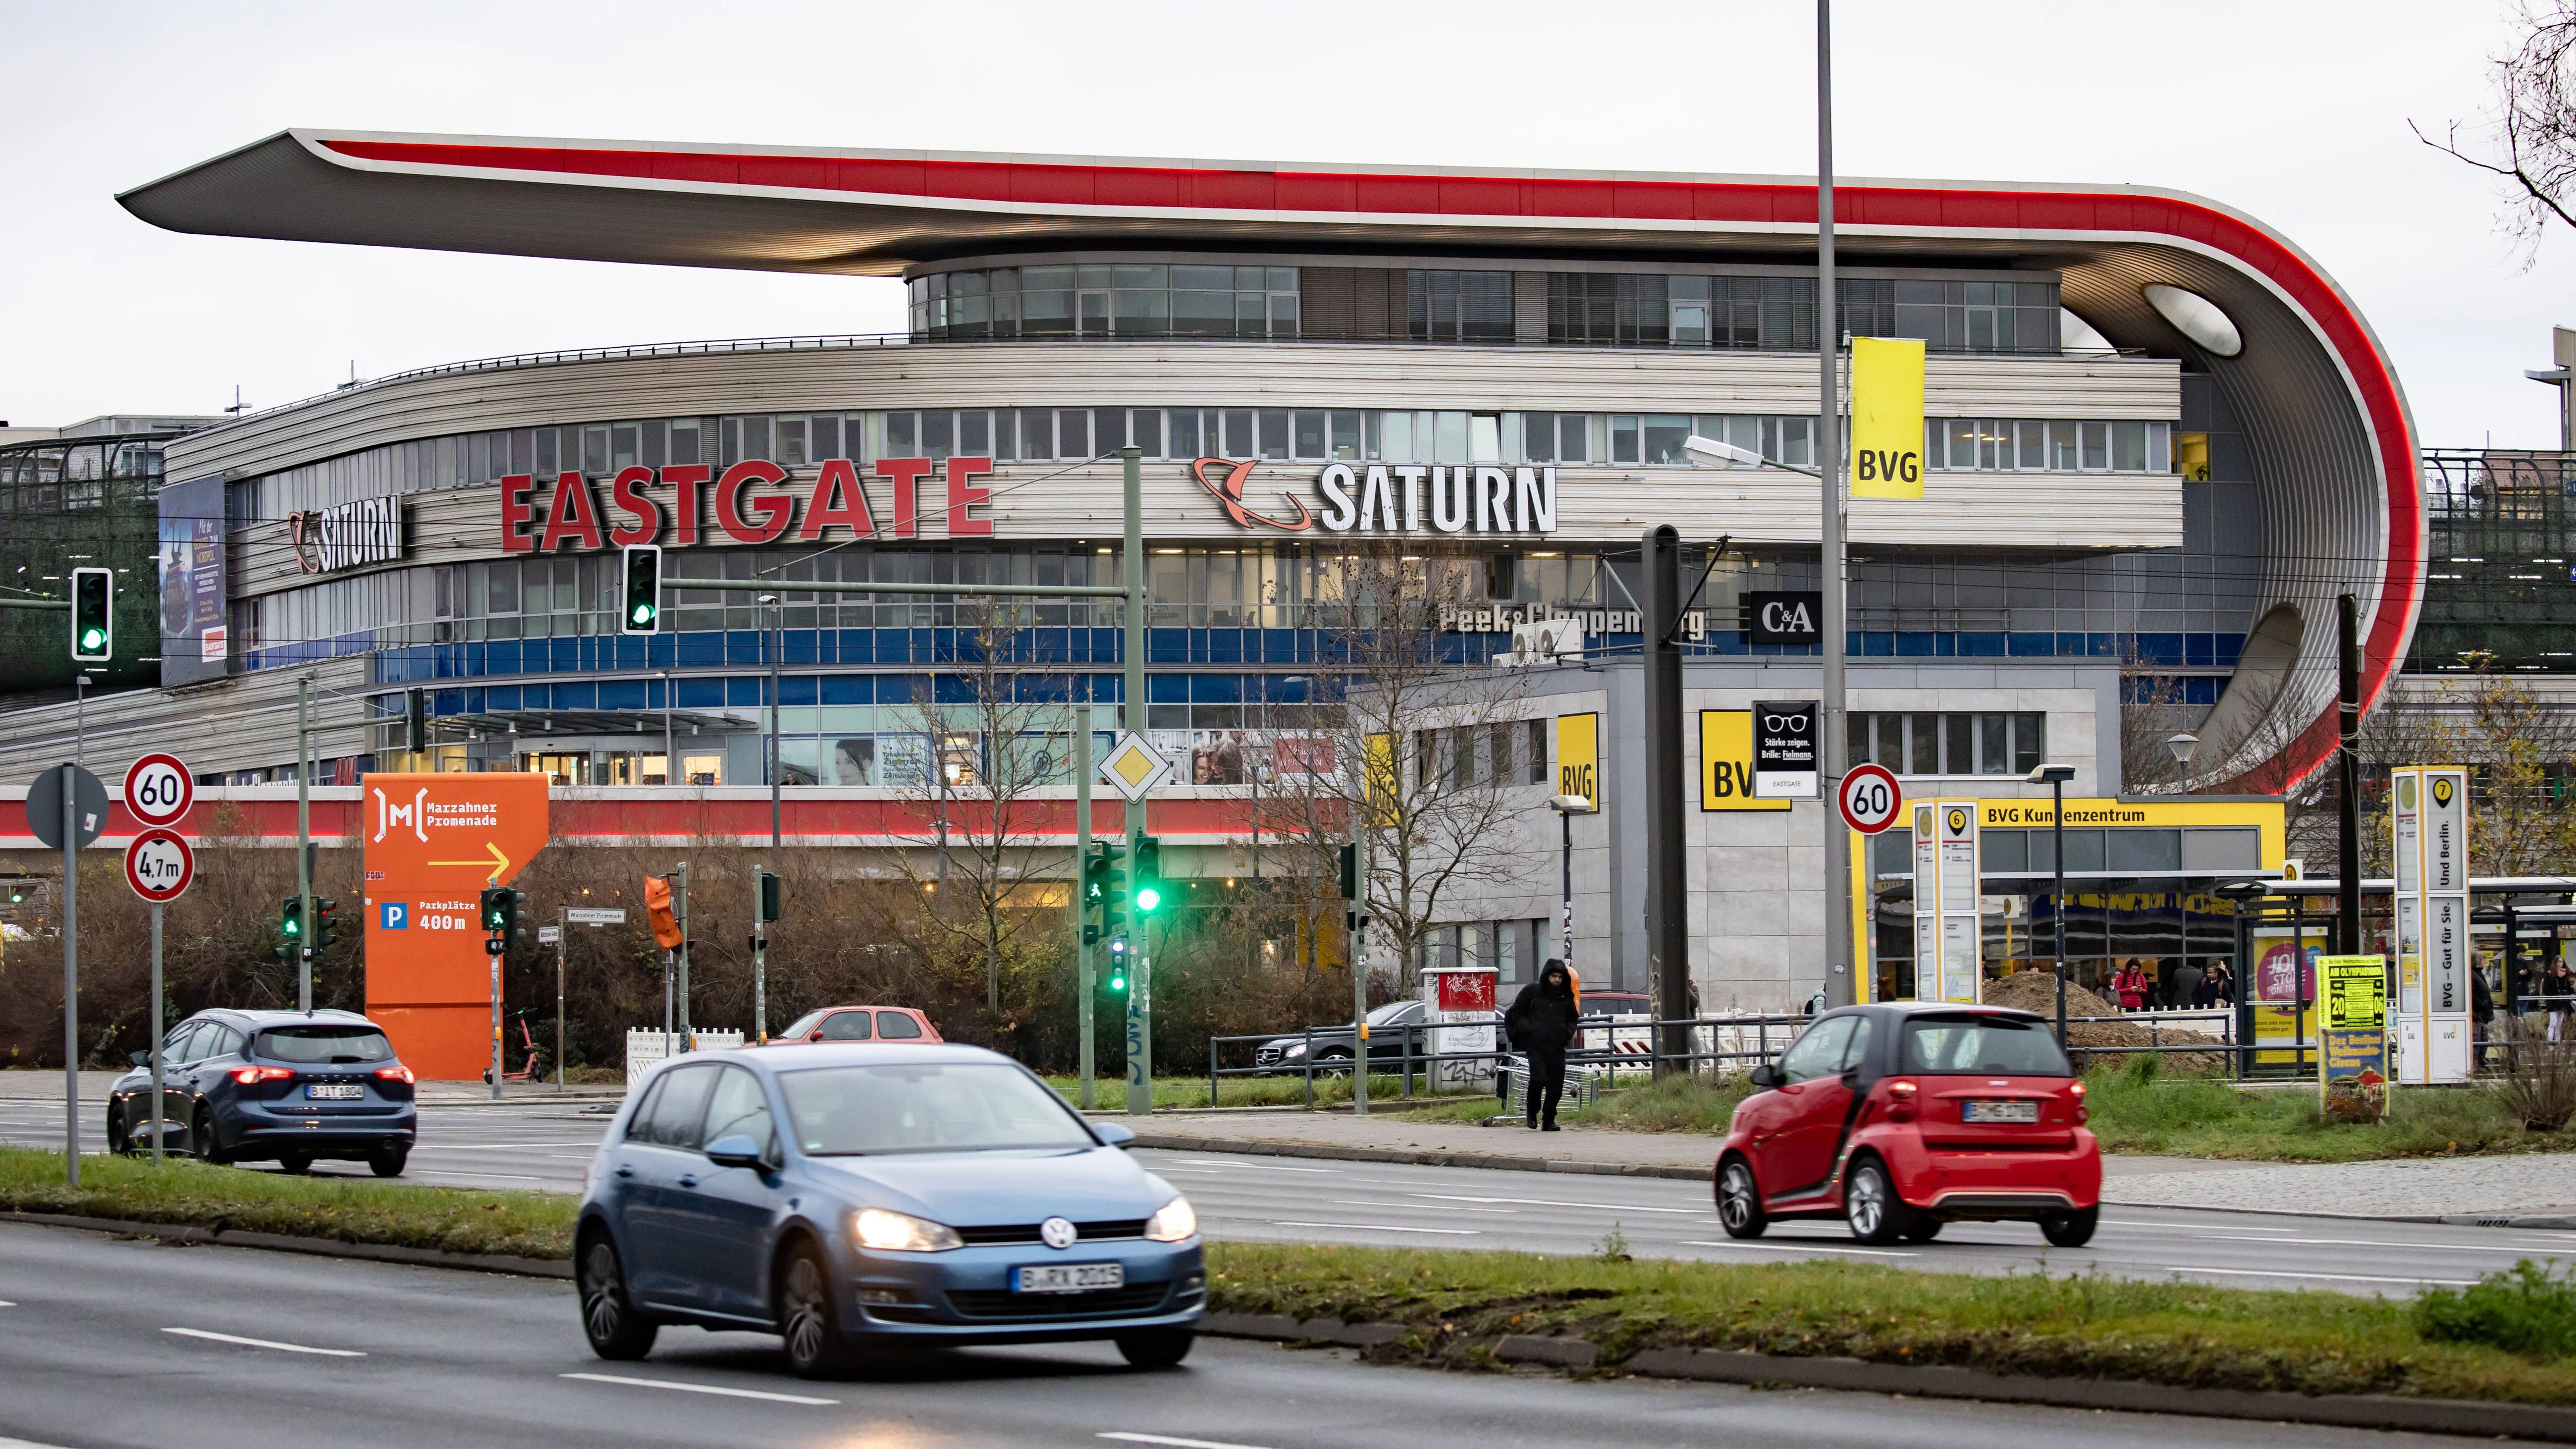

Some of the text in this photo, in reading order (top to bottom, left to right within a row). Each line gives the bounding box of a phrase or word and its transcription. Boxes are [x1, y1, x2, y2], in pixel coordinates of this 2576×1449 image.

[1859, 449, 1917, 483] BVG
[500, 456, 994, 553] EASTGATE
[1320, 463, 1557, 532] SATURN
[322, 495, 397, 572] SATURN
[1762, 602, 1815, 632] C&A
[1765, 738, 1810, 748] Stärke zeigen.
[1762, 750, 1814, 760] Brille: Fielmann.
[1562, 763, 1592, 801] BVG
[1714, 761, 1753, 798] BV
[140, 774, 177, 805] 60
[2439, 785, 2446, 796] 7
[427, 802, 497, 813] Marzahner
[1853, 785, 1888, 815] 60
[427, 815, 497, 826] Promenade
[1954, 815, 1960, 825] 6
[1988, 808, 2145, 823] BVG Kunenzentrum
[2439, 820, 2450, 886] Und Berlin.
[166, 863, 179, 877] m
[420, 901, 476, 911] Parkplätze
[2441, 902, 2451, 923] Sie.
[388, 907, 402, 927] P
[420, 915, 466, 930] 400 m
[2442, 927, 2451, 945] für
[2443, 948, 2452, 969] Gut
[2273, 969, 2306, 986] STOE
[2330, 967, 2339, 977] AM
[2271, 986, 2283, 995] ON
[2443, 982, 2452, 1008] BVG
[2331, 997, 2345, 1015] 20
[2374, 996, 2383, 1014] 06
[312, 1087, 318, 1096] B
[1022, 1270, 1032, 1288] B
